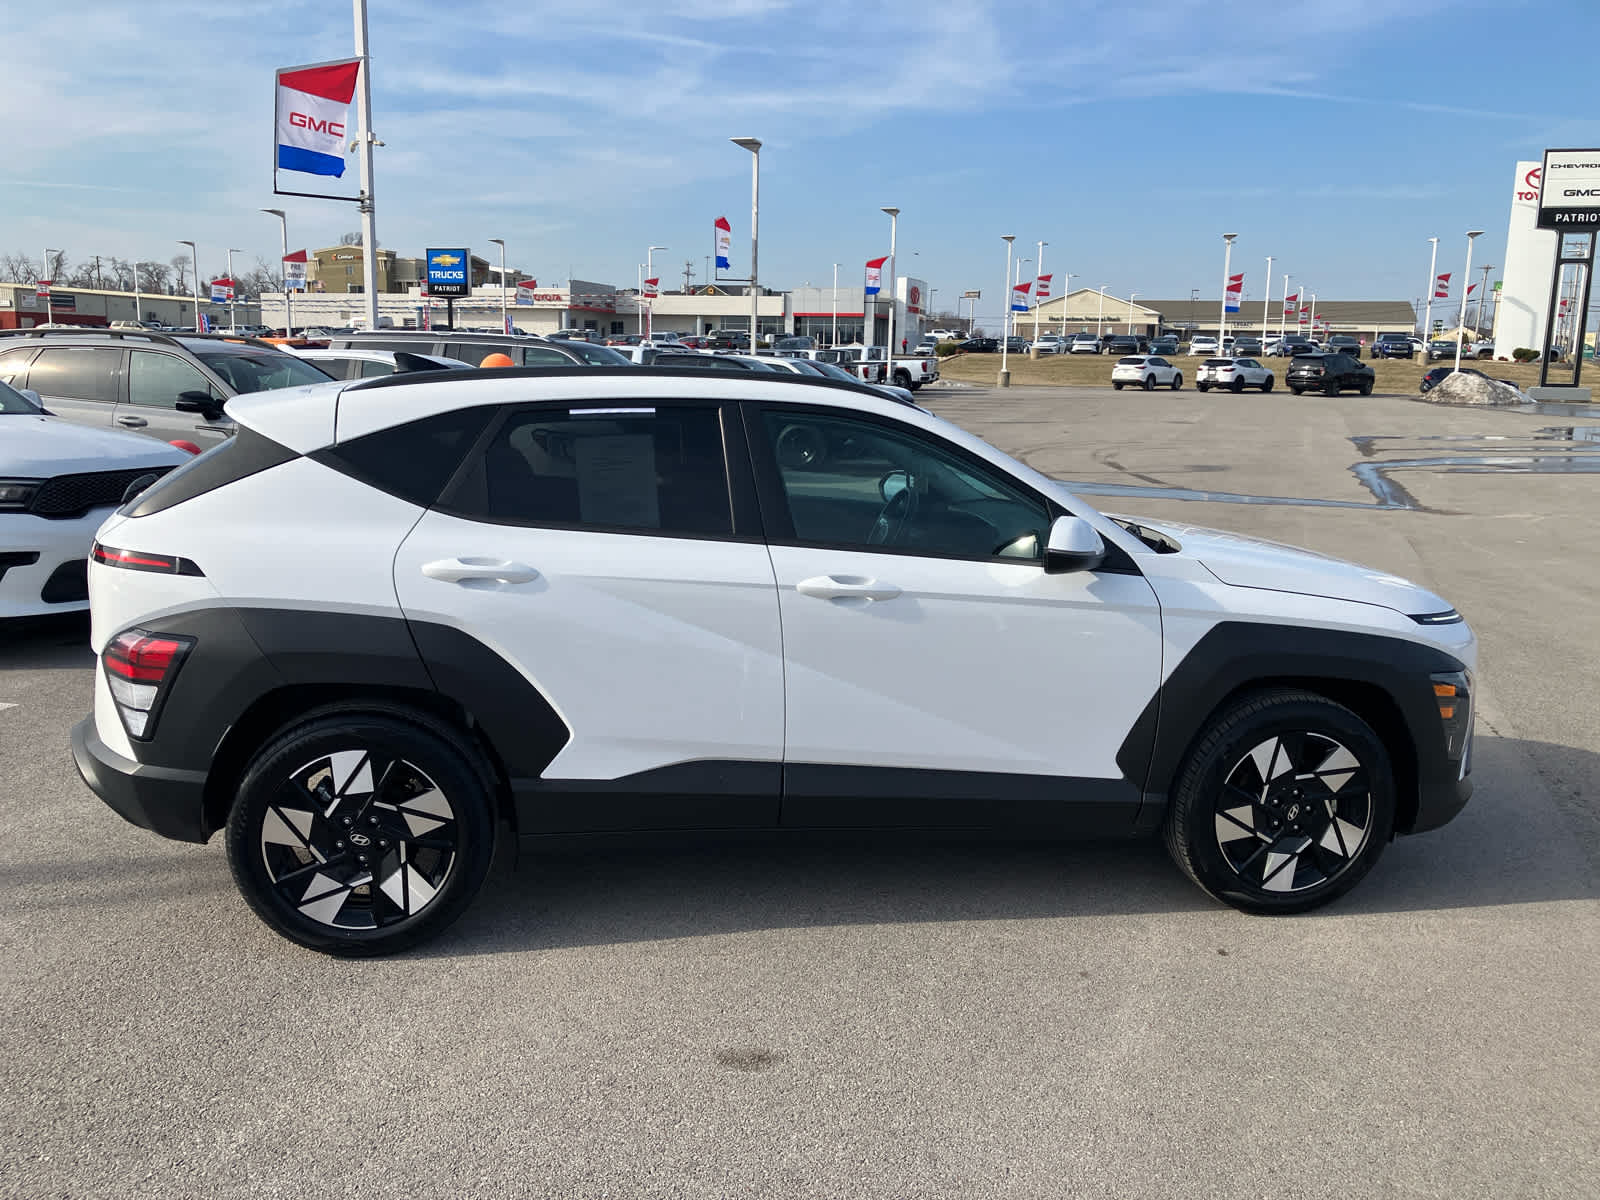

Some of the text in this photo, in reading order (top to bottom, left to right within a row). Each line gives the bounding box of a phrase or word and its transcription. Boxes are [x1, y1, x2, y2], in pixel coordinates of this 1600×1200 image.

[289, 111, 345, 138] GMC
[1517, 192, 1539, 201] TOY
[1563, 189, 1600, 197] GMC
[428, 270, 464, 279] TRUCKS
